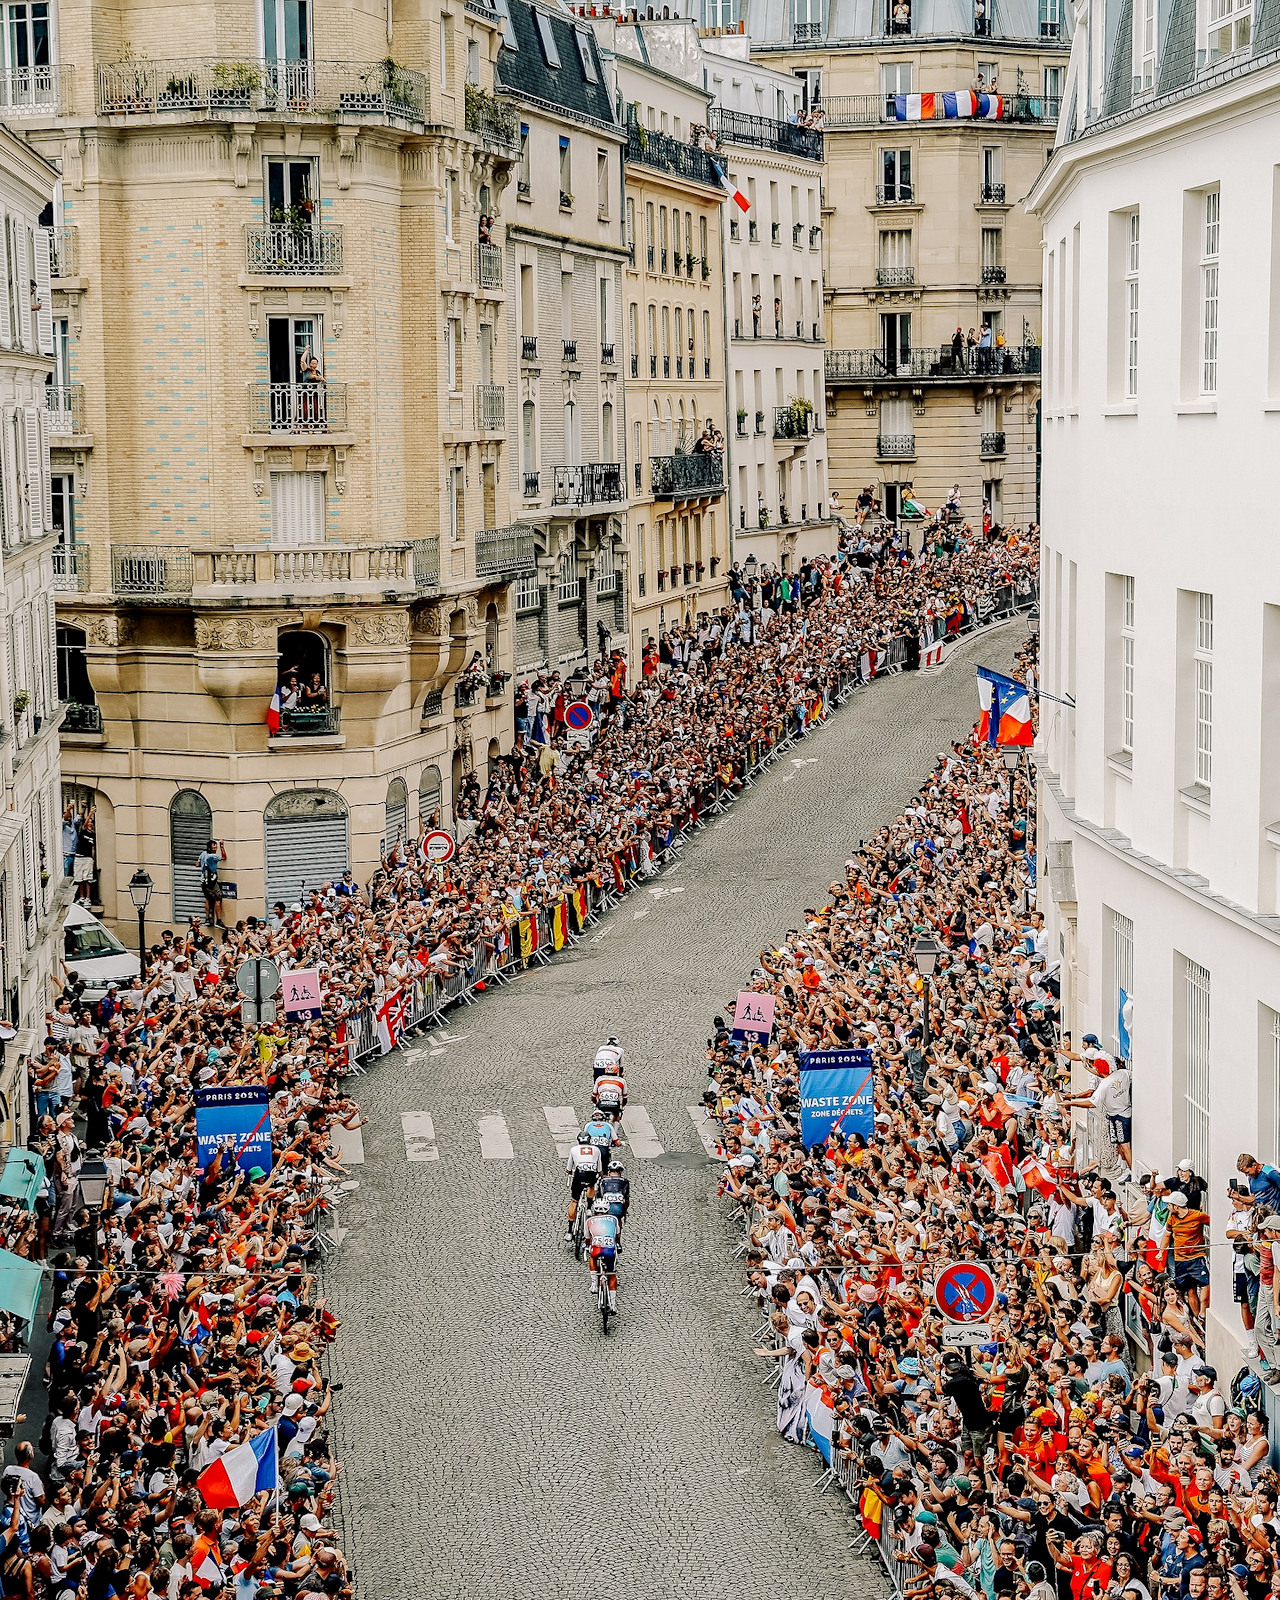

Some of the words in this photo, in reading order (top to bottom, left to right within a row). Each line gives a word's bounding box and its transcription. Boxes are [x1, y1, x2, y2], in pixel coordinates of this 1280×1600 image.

[297, 1010, 313, 1020] 43
[744, 1031, 759, 1042] 43
[206, 1093, 233, 1101] PARIS
[801, 1097, 840, 1108] WASTE
[842, 1095, 873, 1105] ZONE
[811, 1110, 831, 1118] ZONE
[831, 1108, 864, 1117] DÉCHETS
[198, 1133, 238, 1146] WASTE
[239, 1132, 271, 1142] ZONE
[593, 1237, 603, 1245] 25
